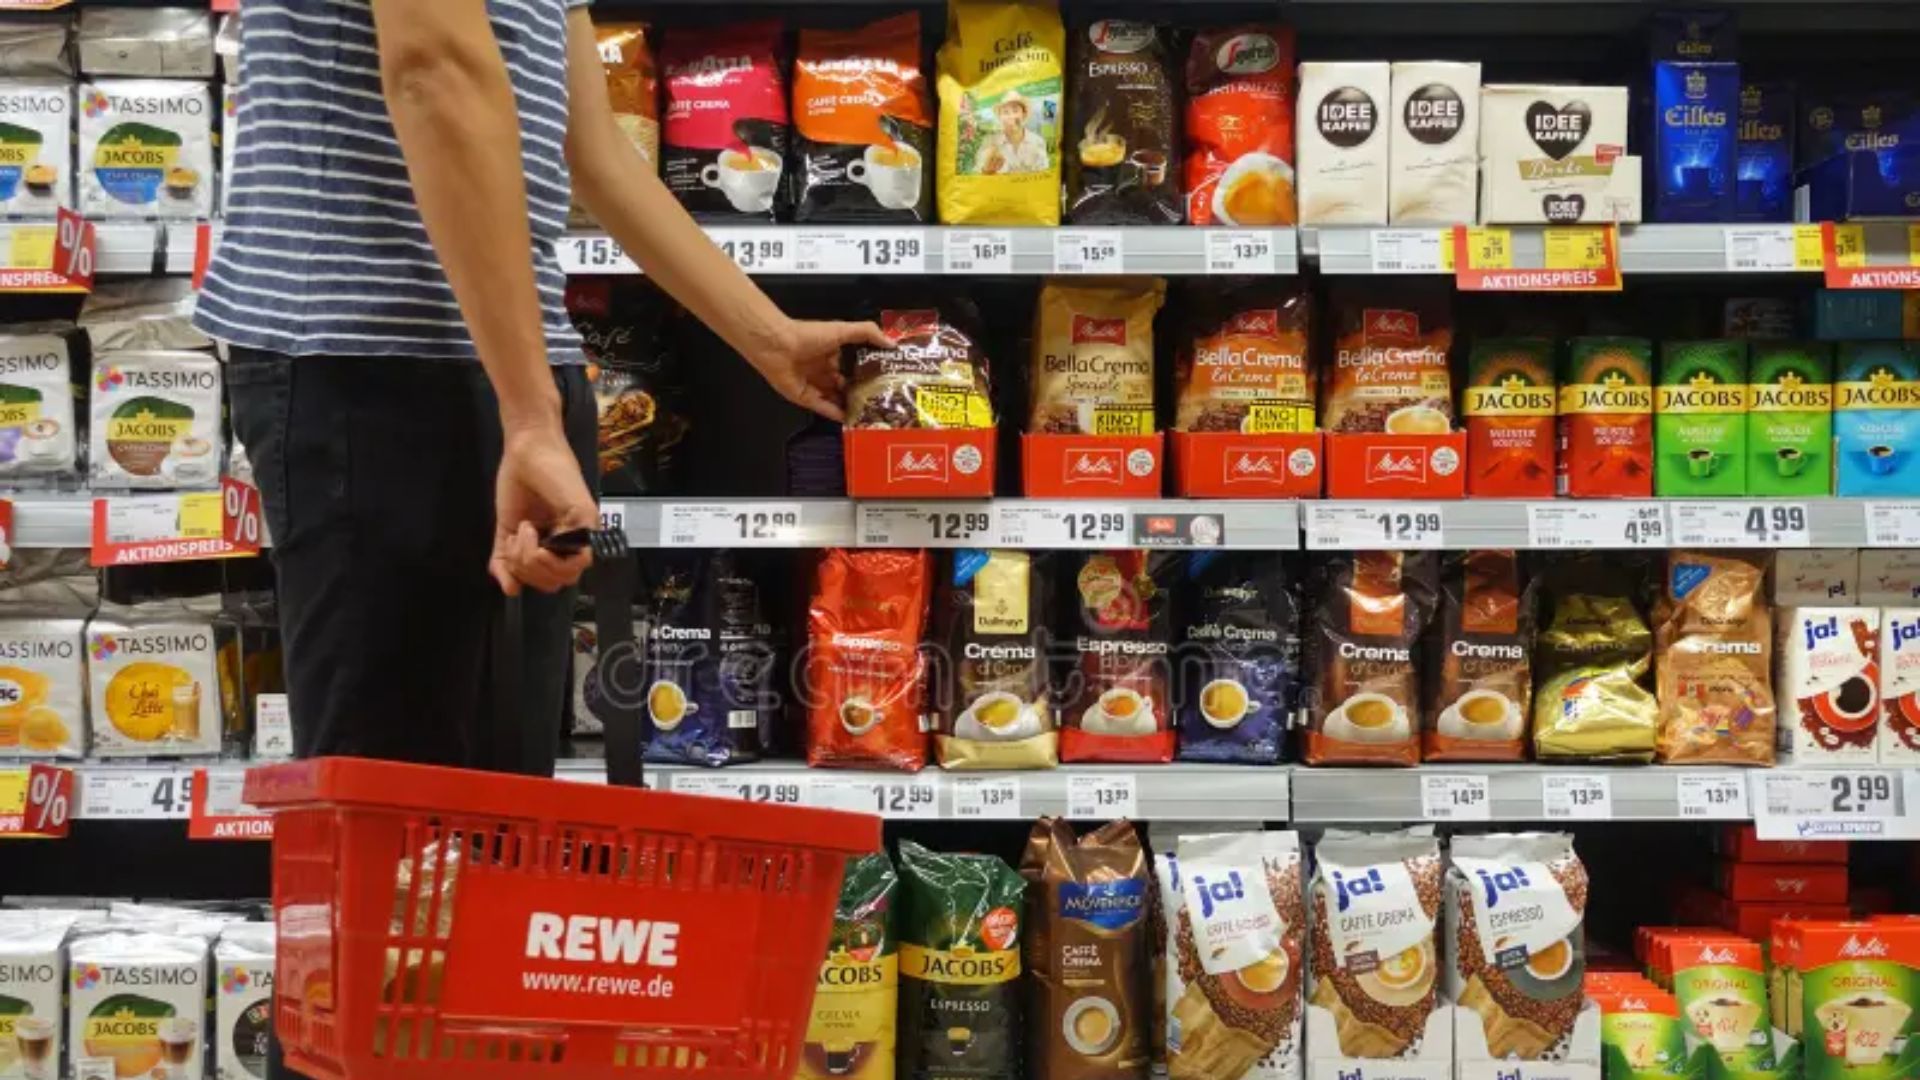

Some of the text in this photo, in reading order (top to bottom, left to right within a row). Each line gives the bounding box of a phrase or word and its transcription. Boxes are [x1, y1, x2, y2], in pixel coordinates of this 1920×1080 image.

[111, 95, 203, 116] TASSIMO
[1321, 104, 1371, 119] IDEE
[1408, 100, 1459, 118] IDEE
[1408, 118, 1458, 130] KAFFEE
[1534, 114, 1582, 131] IDEE
[1665, 105, 1727, 127] Eilles
[1321, 120, 1371, 132] KAFFEE
[1739, 120, 1783, 141] illes
[1534, 130, 1581, 142] KAFFEE
[1845, 133, 1900, 150] Eilles
[104, 149, 165, 165] JACOBS
[857, 239, 920, 265] 13.99
[1482, 271, 1597, 288] AKTIONSPREIS
[1850, 270, 1920, 287] AKTIONS
[1045, 354, 1150, 377] BellaCrema
[126, 371, 215, 390] TASSIMO
[1475, 392, 1552, 411] JACOBS
[1579, 390, 1650, 409] JACOBS
[1662, 390, 1742, 409] JACOBS
[1753, 390, 1829, 409] JACOBS
[1843, 388, 1920, 406] JACOBS
[115, 422, 177, 438] JACOBS
[734, 512, 797, 540] 12.99
[926, 512, 990, 539] 12.99
[1063, 513, 1125, 540] 12.99
[1377, 512, 1441, 541] 12.99
[1624, 520, 1663, 545] 4.99
[1744, 506, 1805, 542] 4.99
[978, 616, 1024, 628] Dallmayr
[117, 633, 207, 654] TASSIMO
[660, 627, 711, 641] Crema
[1803, 617, 1839, 651] ja!
[965, 642, 1036, 660] Crema
[1076, 637, 1168, 656] Espresso
[1339, 643, 1411, 663] Crema
[1451, 640, 1523, 659] Crema
[738, 783, 800, 803] 1299
[872, 785, 934, 813] 12.99
[1830, 775, 1890, 813] 2.99
[1193, 871, 1246, 919] ja!
[1331, 868, 1385, 913] ja!
[1476, 865, 1531, 909] ja!
[1488, 904, 1546, 930] ESPRESSO
[525, 911, 680, 967] REWE
[1838, 935, 1890, 958] Melitta
[1697, 945, 1739, 964] Melitta
[0, 964, 54, 983] SIMO
[818, 964, 882, 985] COBS
[922, 954, 1006, 977] JACOBS
[101, 965, 198, 986] TASSIMO
[522, 969, 674, 999] www.rewe.de
[1831, 975, 1898, 989] ORIGINAL
[930, 998, 991, 1012] ESPRESSO
[94, 1021, 158, 1036] JACOBS
